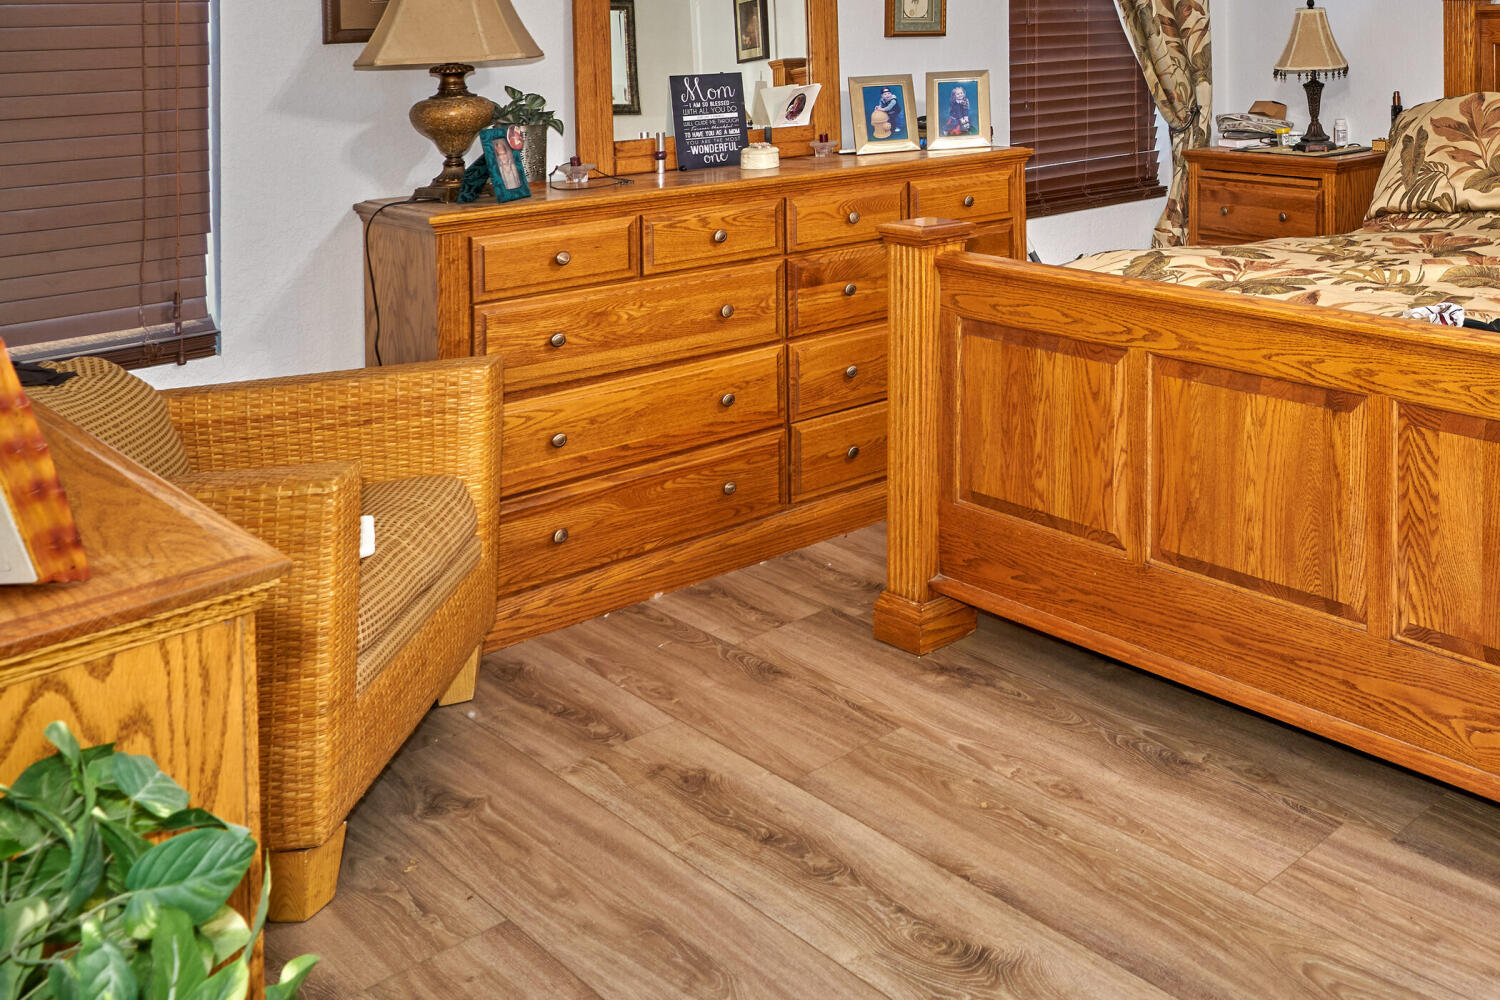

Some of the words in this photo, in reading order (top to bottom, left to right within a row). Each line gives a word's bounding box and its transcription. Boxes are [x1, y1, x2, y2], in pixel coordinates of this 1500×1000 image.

[681, 77, 735, 102] Mom
[690, 142, 738, 155] WONDERFUL
[703, 153, 728, 163] one
